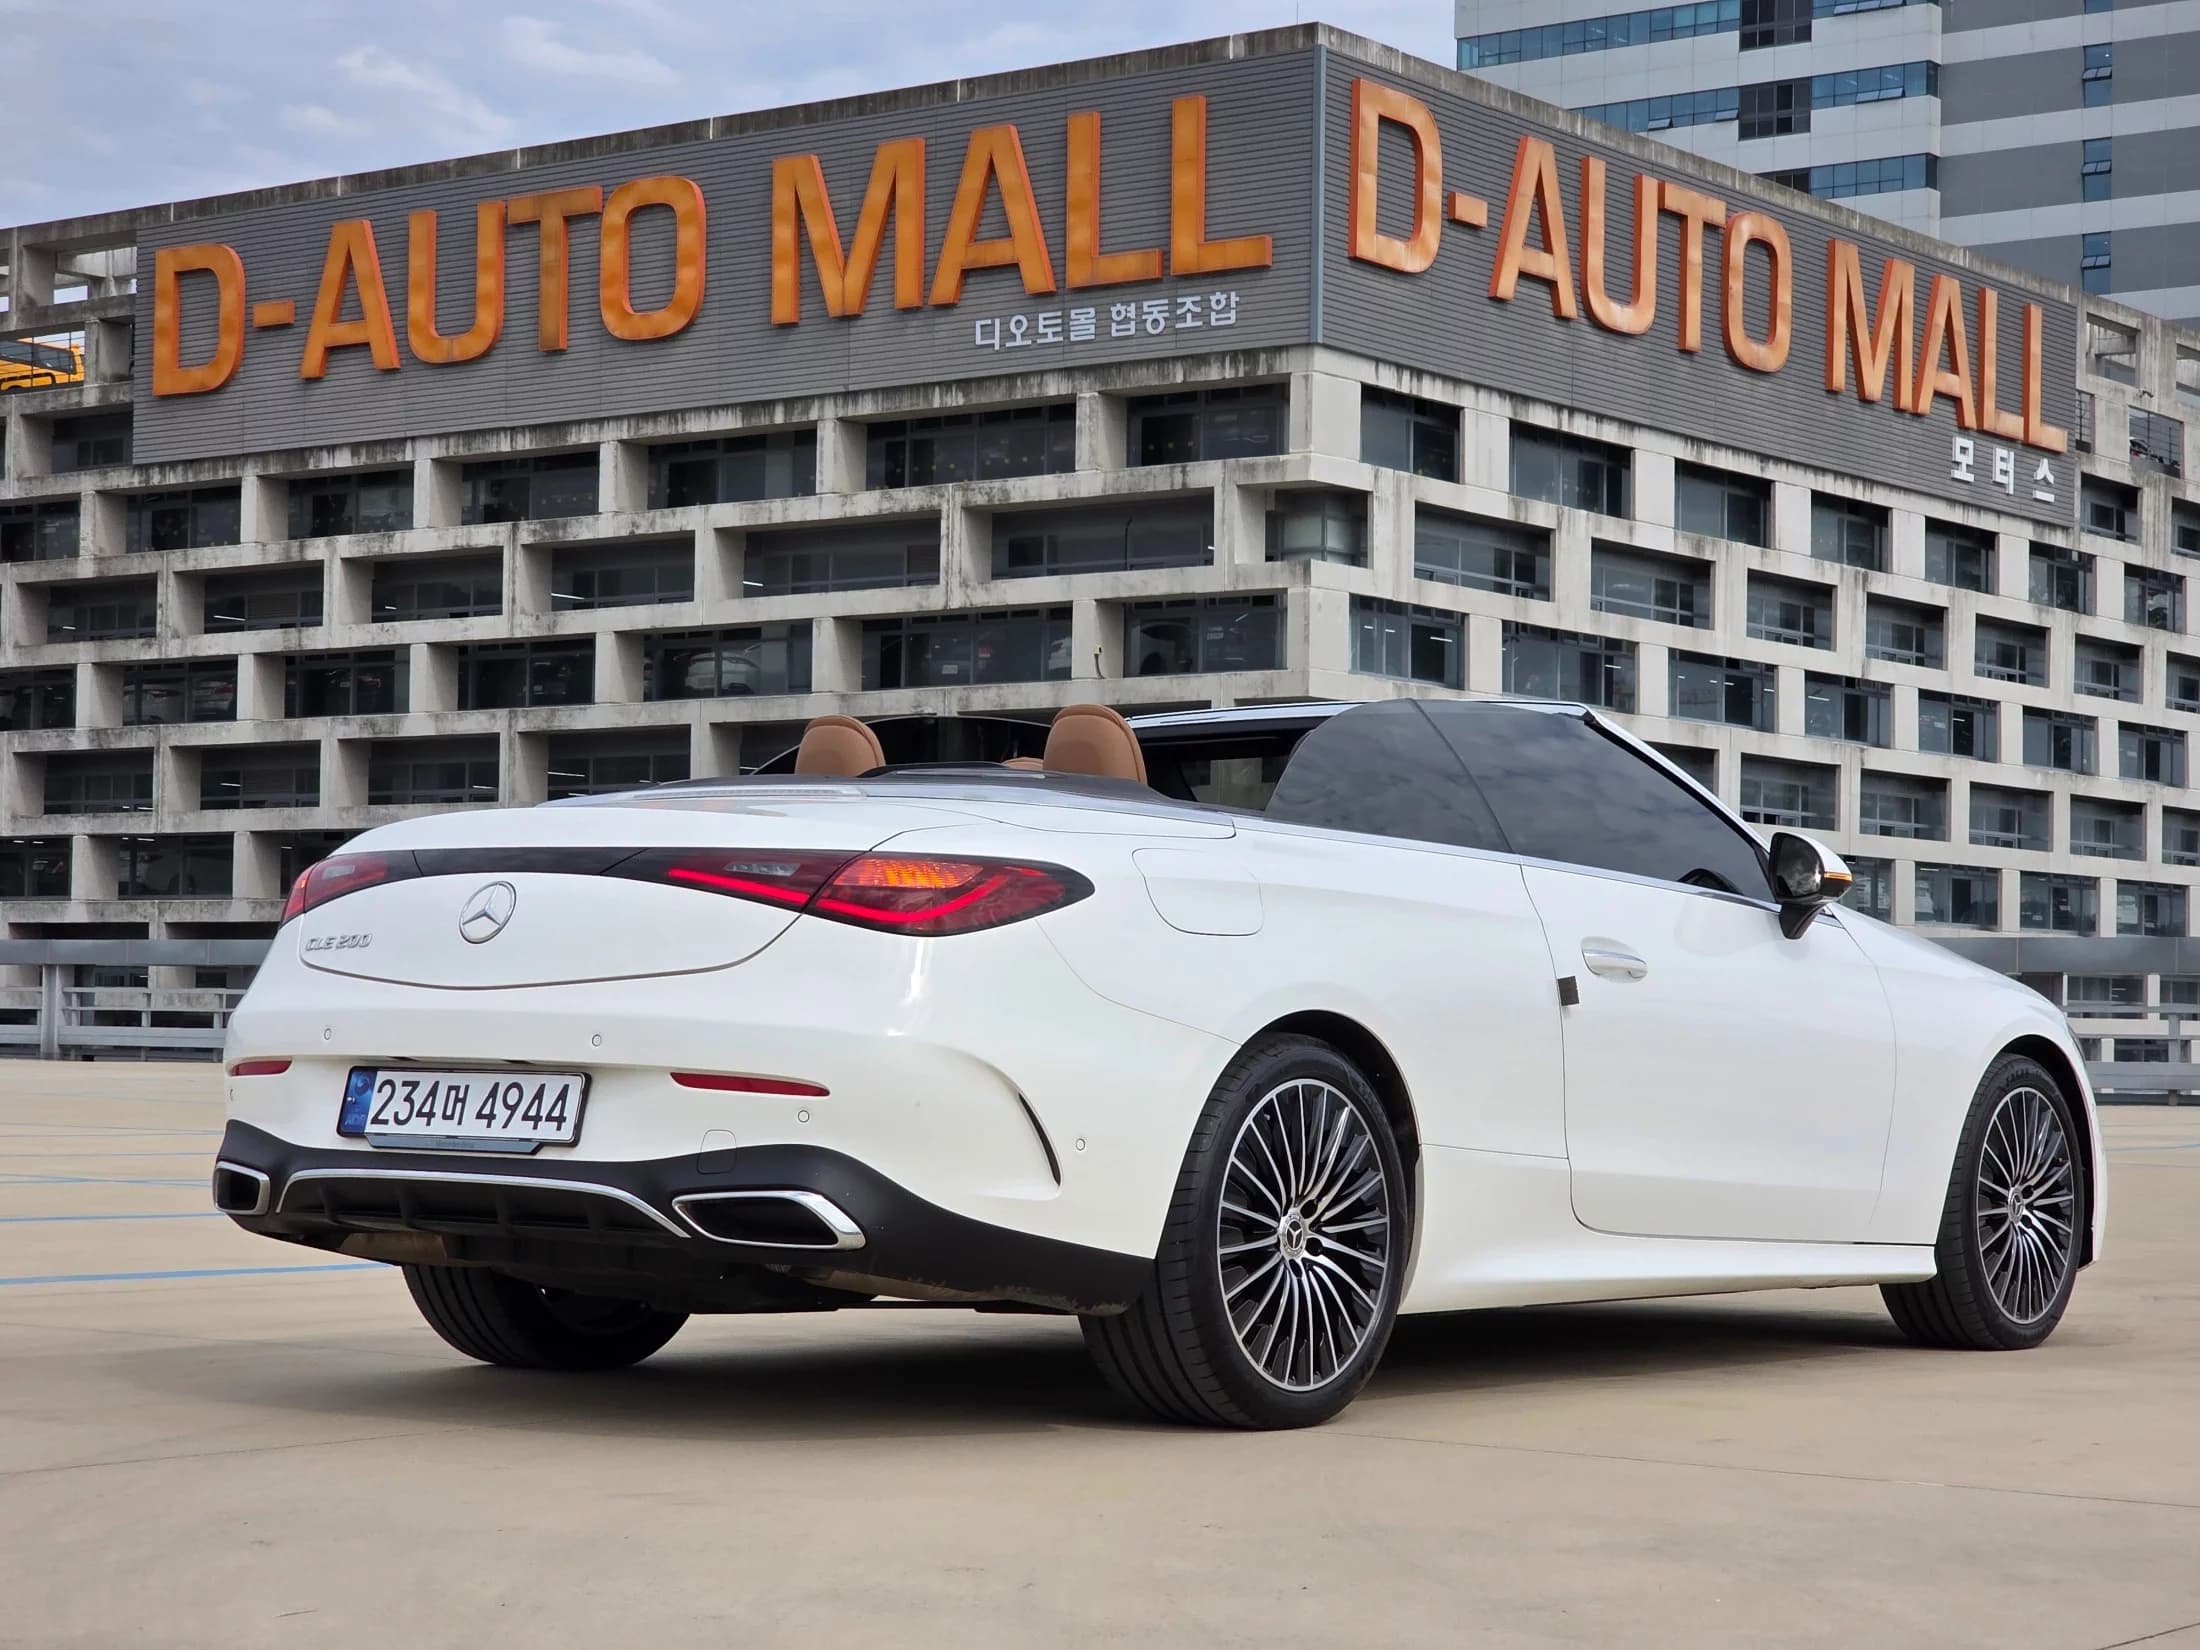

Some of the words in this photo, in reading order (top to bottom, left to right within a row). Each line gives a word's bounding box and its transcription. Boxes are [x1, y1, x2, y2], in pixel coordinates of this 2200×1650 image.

[152, 175, 707, 397] D-AUTO
[771, 95, 1273, 325] MALL
[1348, 77, 1793, 373] D-AUTO
[1825, 239, 2068, 454] MALL
[975, 307, 1097, 350] 디오토몰
[1110, 291, 1240, 337] 협동조합
[1951, 436, 2055, 503] 모터스
[305, 937, 337, 951] CLE
[336, 933, 374, 949] 200
[370, 1079, 470, 1127] 234머
[475, 1081, 570, 1132] 4944
